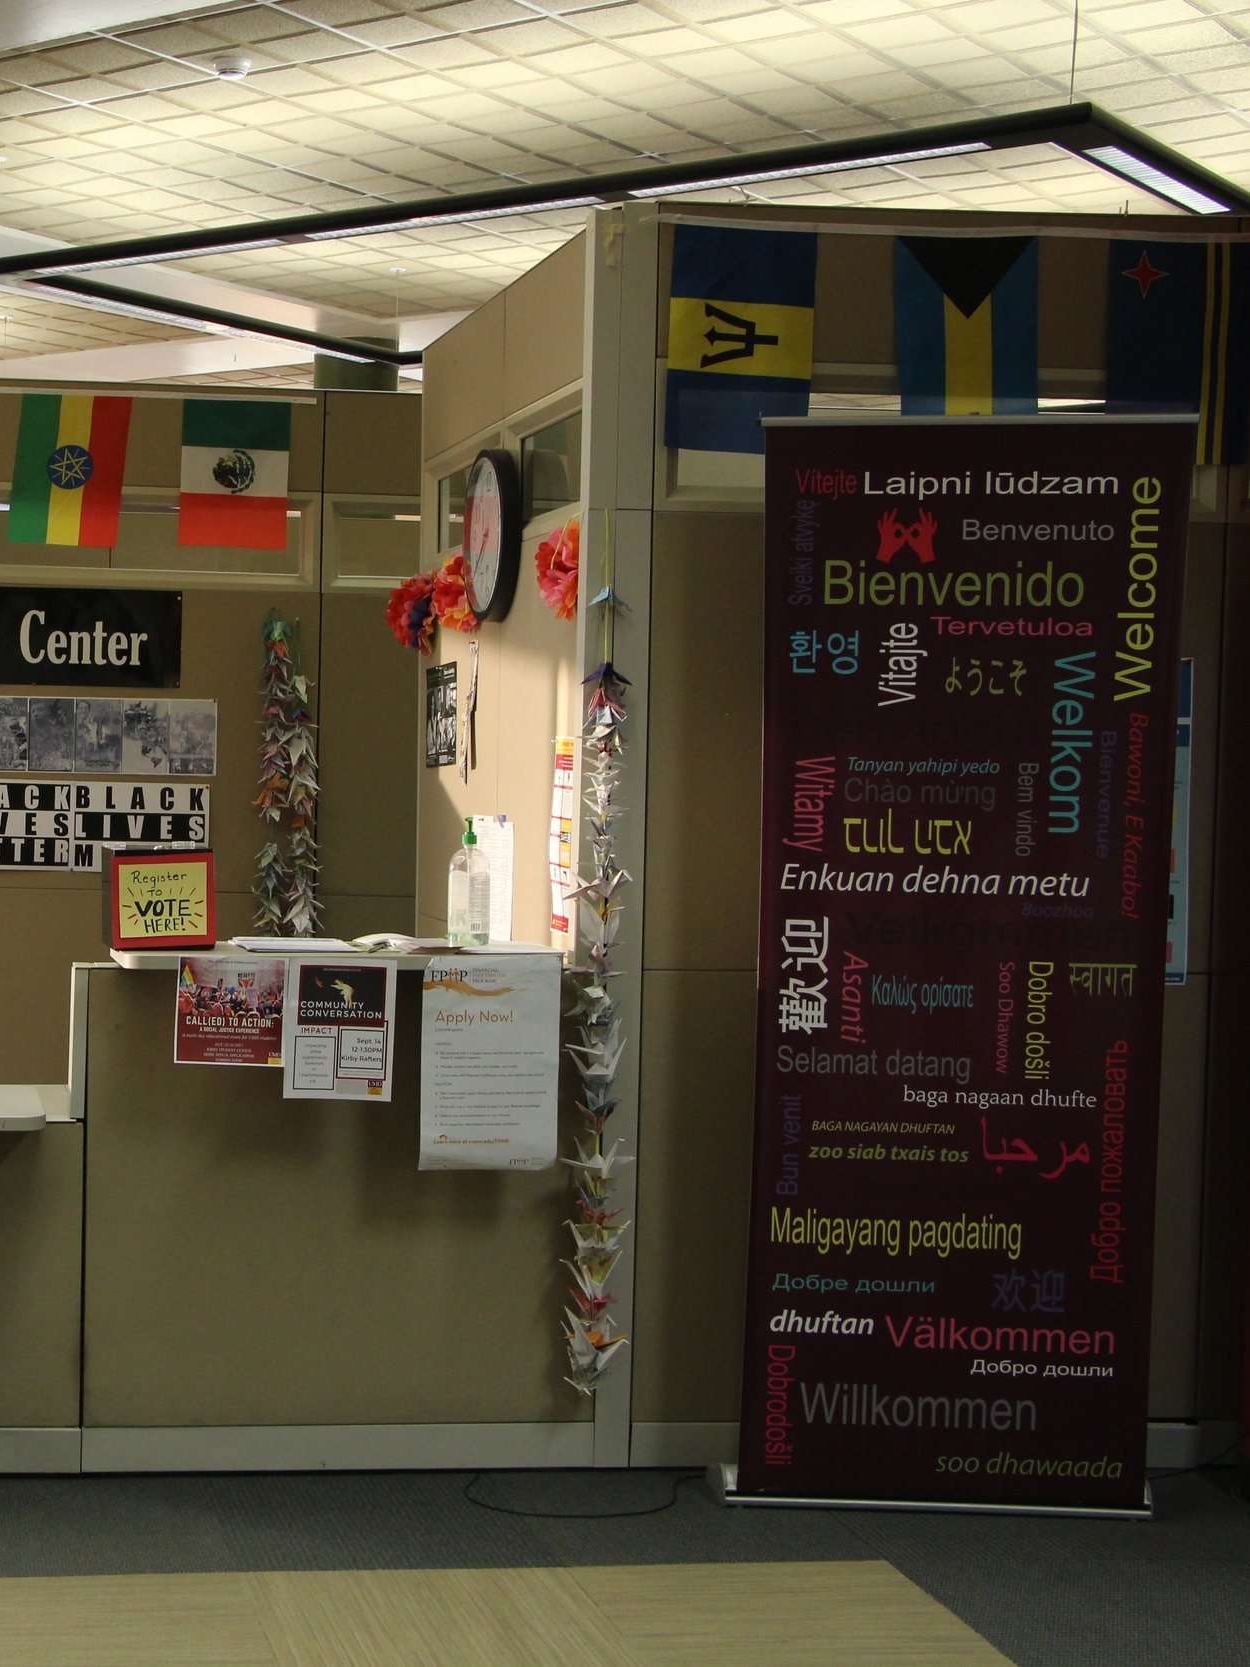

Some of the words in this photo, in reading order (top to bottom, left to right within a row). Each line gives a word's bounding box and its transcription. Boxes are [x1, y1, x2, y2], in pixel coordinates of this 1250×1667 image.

[864, 471, 971, 500] Laipni
[985, 471, 1119, 495] lūdzam
[962, 519, 1115, 542] Benvenuto
[823, 560, 1084, 606] Bienvenido
[1114, 476, 1162, 702] Welcome
[19, 609, 148, 666] Center
[930, 616, 1093, 636] Tervetuloa
[878, 622, 928, 707] Vitajte
[944, 656, 1028, 697] ようこそ
[1047, 650, 1098, 834] Welkom
[847, 756, 904, 775] Tanyan
[907, 757, 958, 777] yahipi
[959, 759, 1000, 777] yedo
[1016, 762, 1040, 803] Bem
[75, 786, 204, 811] BLACK
[782, 755, 837, 853] Witamy
[844, 777, 911, 804] Chào
[1095, 729, 1118, 859] Bienvenue
[75, 814, 204, 840] LIVES
[1015, 809, 1039, 858] vindo
[131, 870, 187, 889] Register
[148, 889, 163, 897] TO
[780, 863, 894, 891] Enkuan
[902, 865, 1000, 894] dehna
[1007, 871, 1091, 897] metu
[134, 899, 192, 917] VOTE
[144, 916, 187, 933] HERE!
[871, 974, 917, 1015] Καλώς
[920, 976, 975, 1015] ορίσατε
[998, 961, 1015, 994] Soo
[1025, 961, 1055, 1025] Dobro
[1068, 962, 1138, 998] स्वागत
[186, 1015, 225, 1027] CALL(ED)
[229, 1017, 239, 1027] TO
[241, 1018, 275, 1028] ACTION:
[300, 1001, 364, 1009] COMMUNITY
[300, 1010, 382, 1019] CONVERSATION
[435, 1009, 475, 1026] Apply
[479, 1009, 514, 1023] Now!
[301, 1027, 333, 1035] IMPACT
[341, 1056, 358, 1064] Kirby
[359, 1055, 383, 1063] Rafters
[776, 1045, 878, 1076] Selamat
[885, 1049, 972, 1085] datang
[1024, 1031, 1052, 1081] došli
[902, 1084, 949, 1108] baga
[954, 1089, 1025, 1110] nagaan
[1030, 1088, 1098, 1108] dhufte
[778, 1093, 802, 1146] venit
[811, 1120, 843, 1132] BAGA
[843, 1121, 899, 1134] NAGAYAN
[900, 1122, 956, 1135] DHUFTAN
[1100, 1039, 1130, 1193] пожаловать
[808, 1146, 844, 1159] zoo
[846, 1143, 886, 1161] siab
[890, 1145, 935, 1162] txais
[939, 1145, 969, 1163] tos
[979, 1114, 1092, 1180] مرحبا
[776, 1153, 799, 1196] Bun
[770, 1206, 901, 1257] Maligayang
[908, 1212, 1022, 1260] pagdating
[1089, 1200, 1127, 1284] Добро
[772, 1273, 848, 1294] Добре
[854, 1279, 936, 1294] дошли
[992, 1267, 1065, 1313] 欢迎
[769, 1309, 874, 1335] dhuftan
[885, 1315, 1116, 1356] Välkommen
[970, 1359, 1038, 1376] Добро
[1042, 1365, 1114, 1378] дошли
[765, 1344, 797, 1466] Dobrodošli
[800, 1382, 1037, 1431] Willkommen
[935, 1455, 980, 1473] soo
[986, 1451, 1123, 1479] dhawaada
